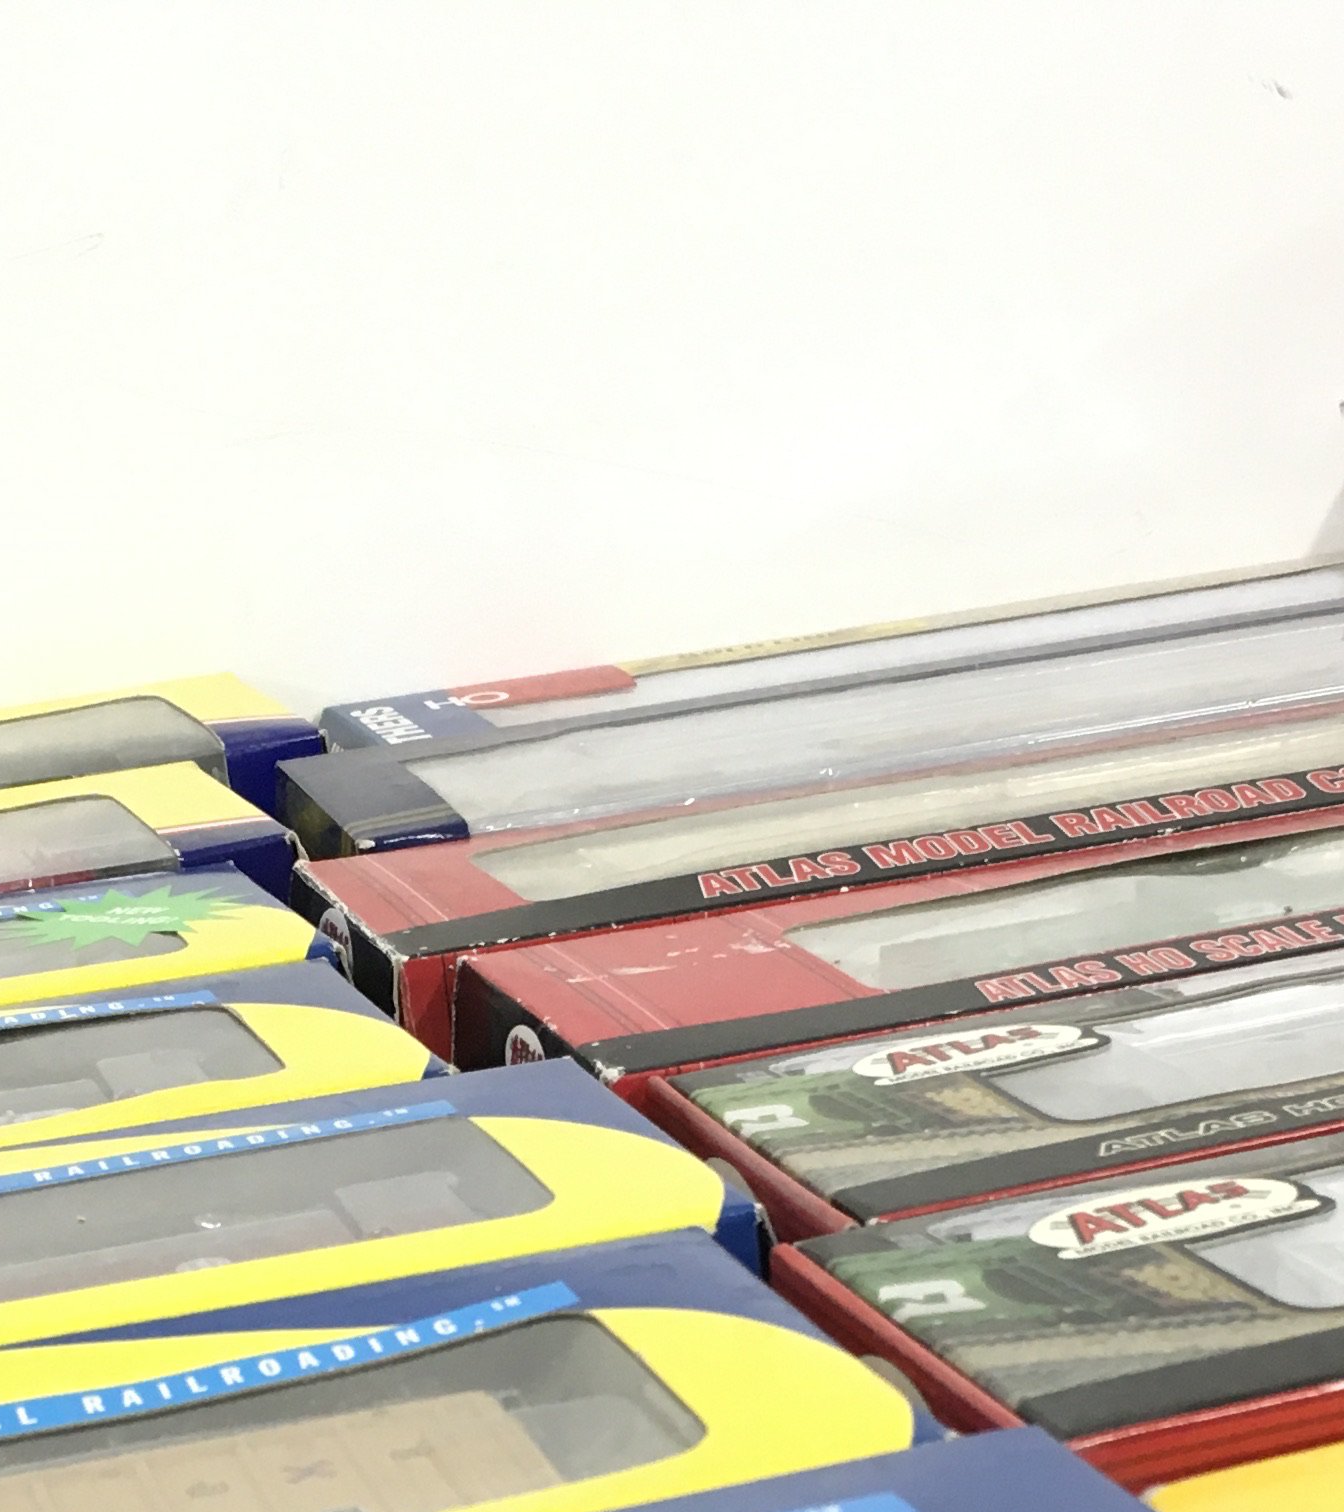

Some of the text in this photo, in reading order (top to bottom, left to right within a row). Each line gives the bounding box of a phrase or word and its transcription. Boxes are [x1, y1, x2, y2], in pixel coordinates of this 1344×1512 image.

[698, 850, 862, 900] ATLAS
[865, 819, 1054, 868] MODEL
[1058, 774, 1307, 840] RAILROAD
[108, 904, 171, 917] NEW
[973, 960, 1124, 1005] ATLAS
[1127, 945, 1193, 978] HO
[886, 1026, 1043, 1075] ATLAS
[1096, 1109, 1279, 1159] ATLAS
[1067, 1180, 1250, 1246] ATLAS
